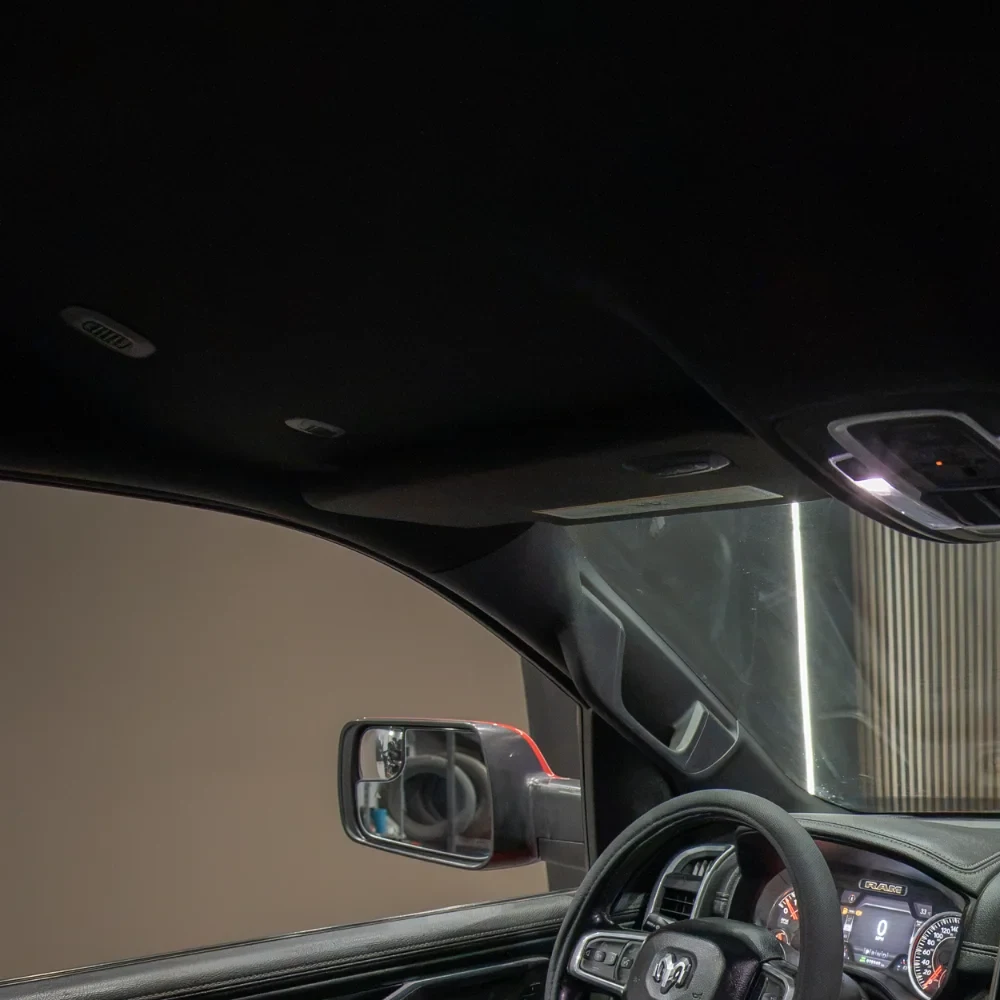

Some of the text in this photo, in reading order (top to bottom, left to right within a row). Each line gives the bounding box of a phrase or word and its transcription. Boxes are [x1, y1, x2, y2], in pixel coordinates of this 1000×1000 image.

[864, 880, 903, 894] RAM
[877, 919, 888, 936] 0
[933, 931, 943, 939] 100
